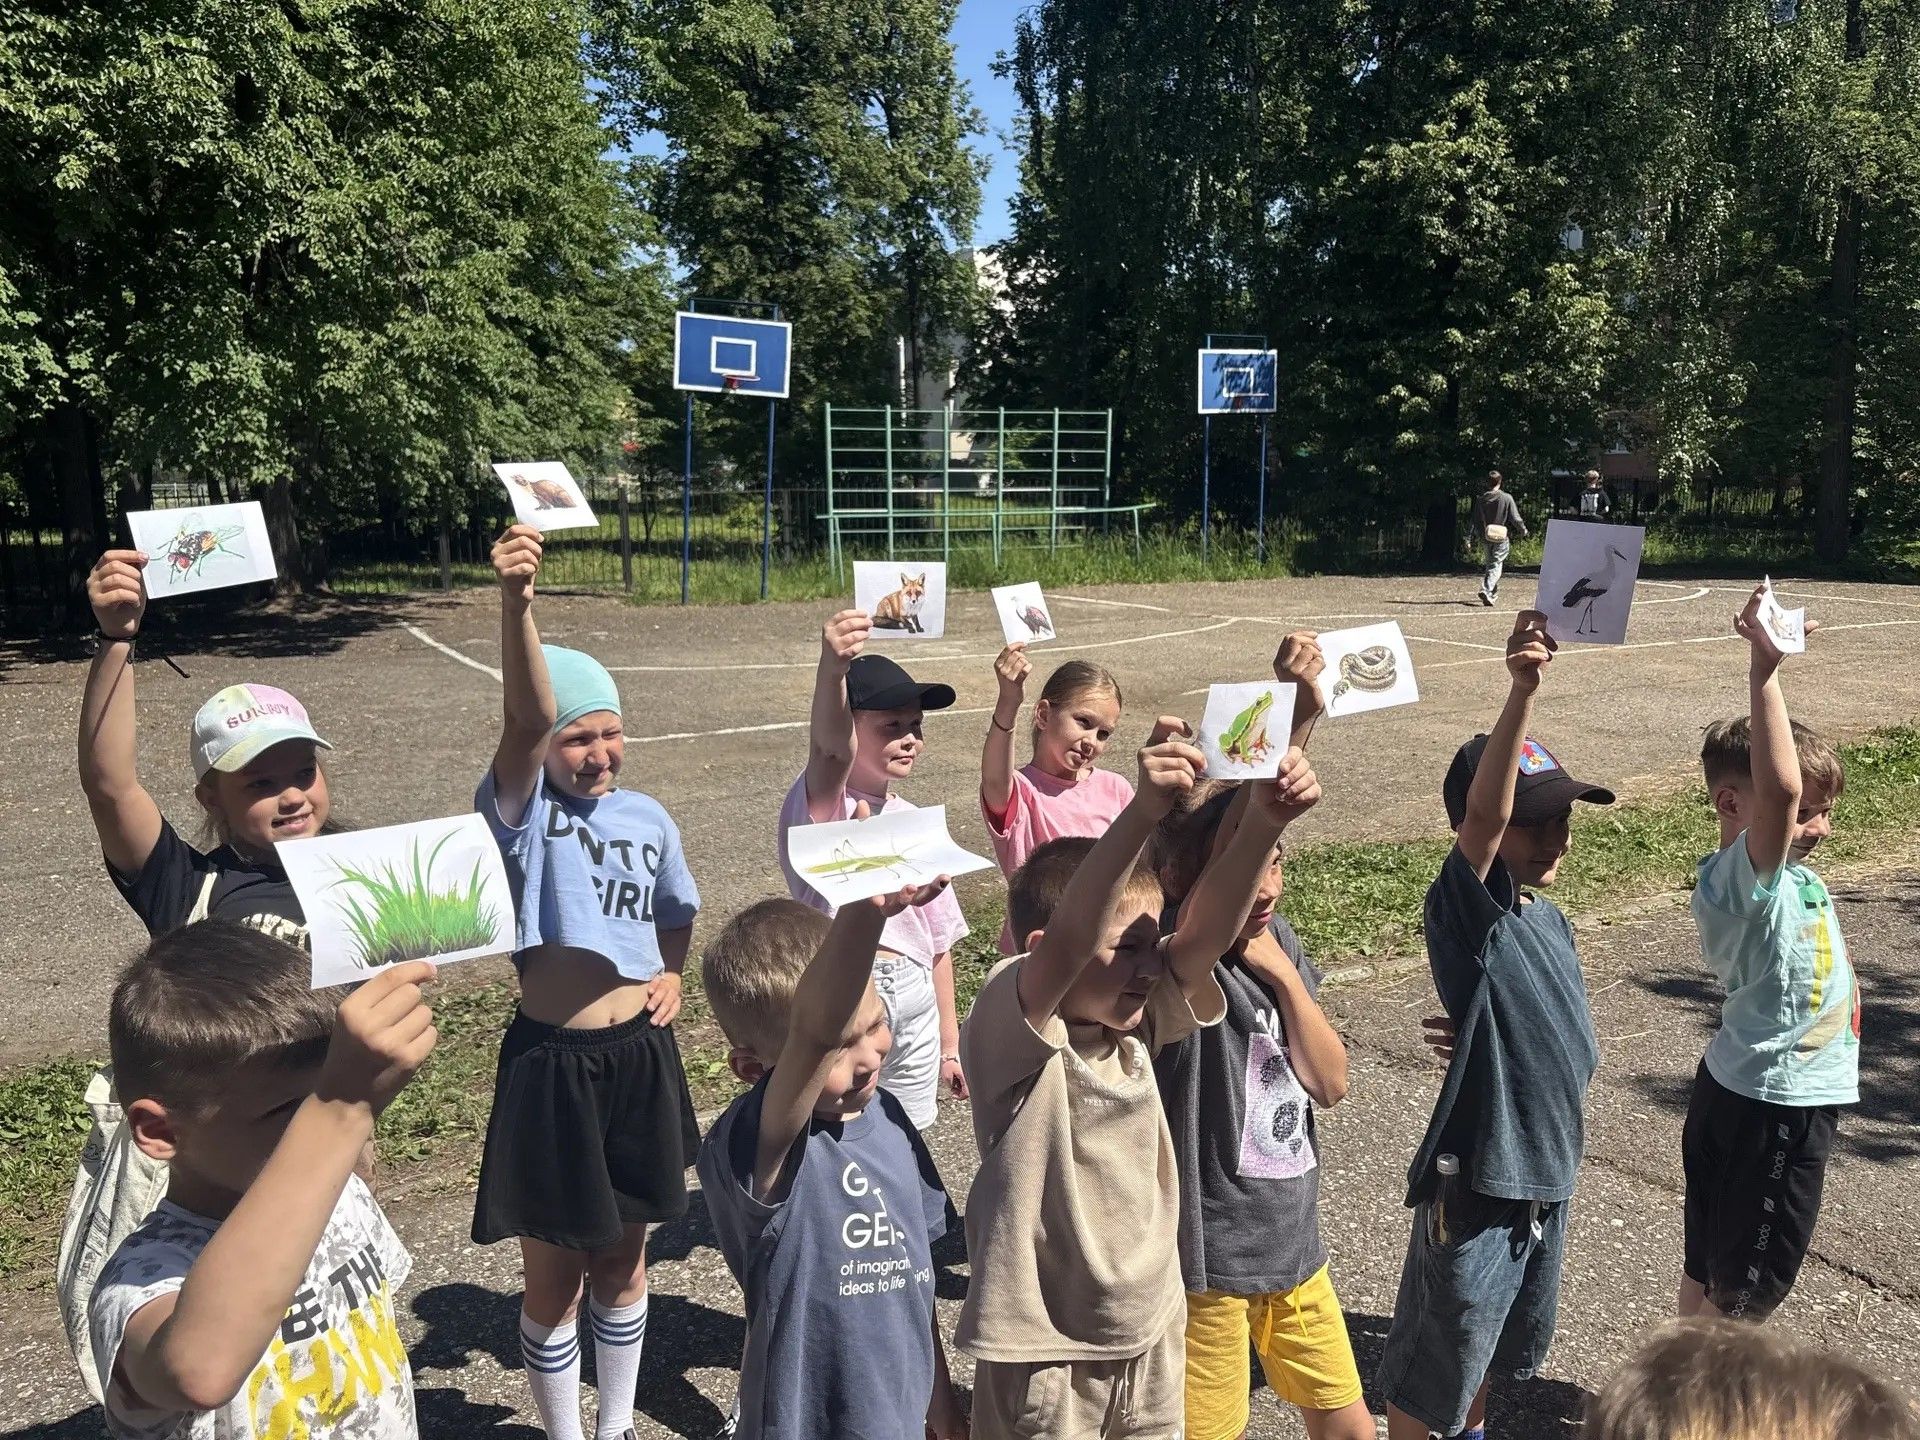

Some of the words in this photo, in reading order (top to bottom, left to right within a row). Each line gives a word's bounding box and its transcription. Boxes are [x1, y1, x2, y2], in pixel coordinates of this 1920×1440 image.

[226, 703, 290, 729] SUNNY
[840, 1259, 854, 1276] of
[839, 1280, 874, 1296] ideas
[878, 1278, 889, 1292] to
[890, 1275, 906, 1290] life
